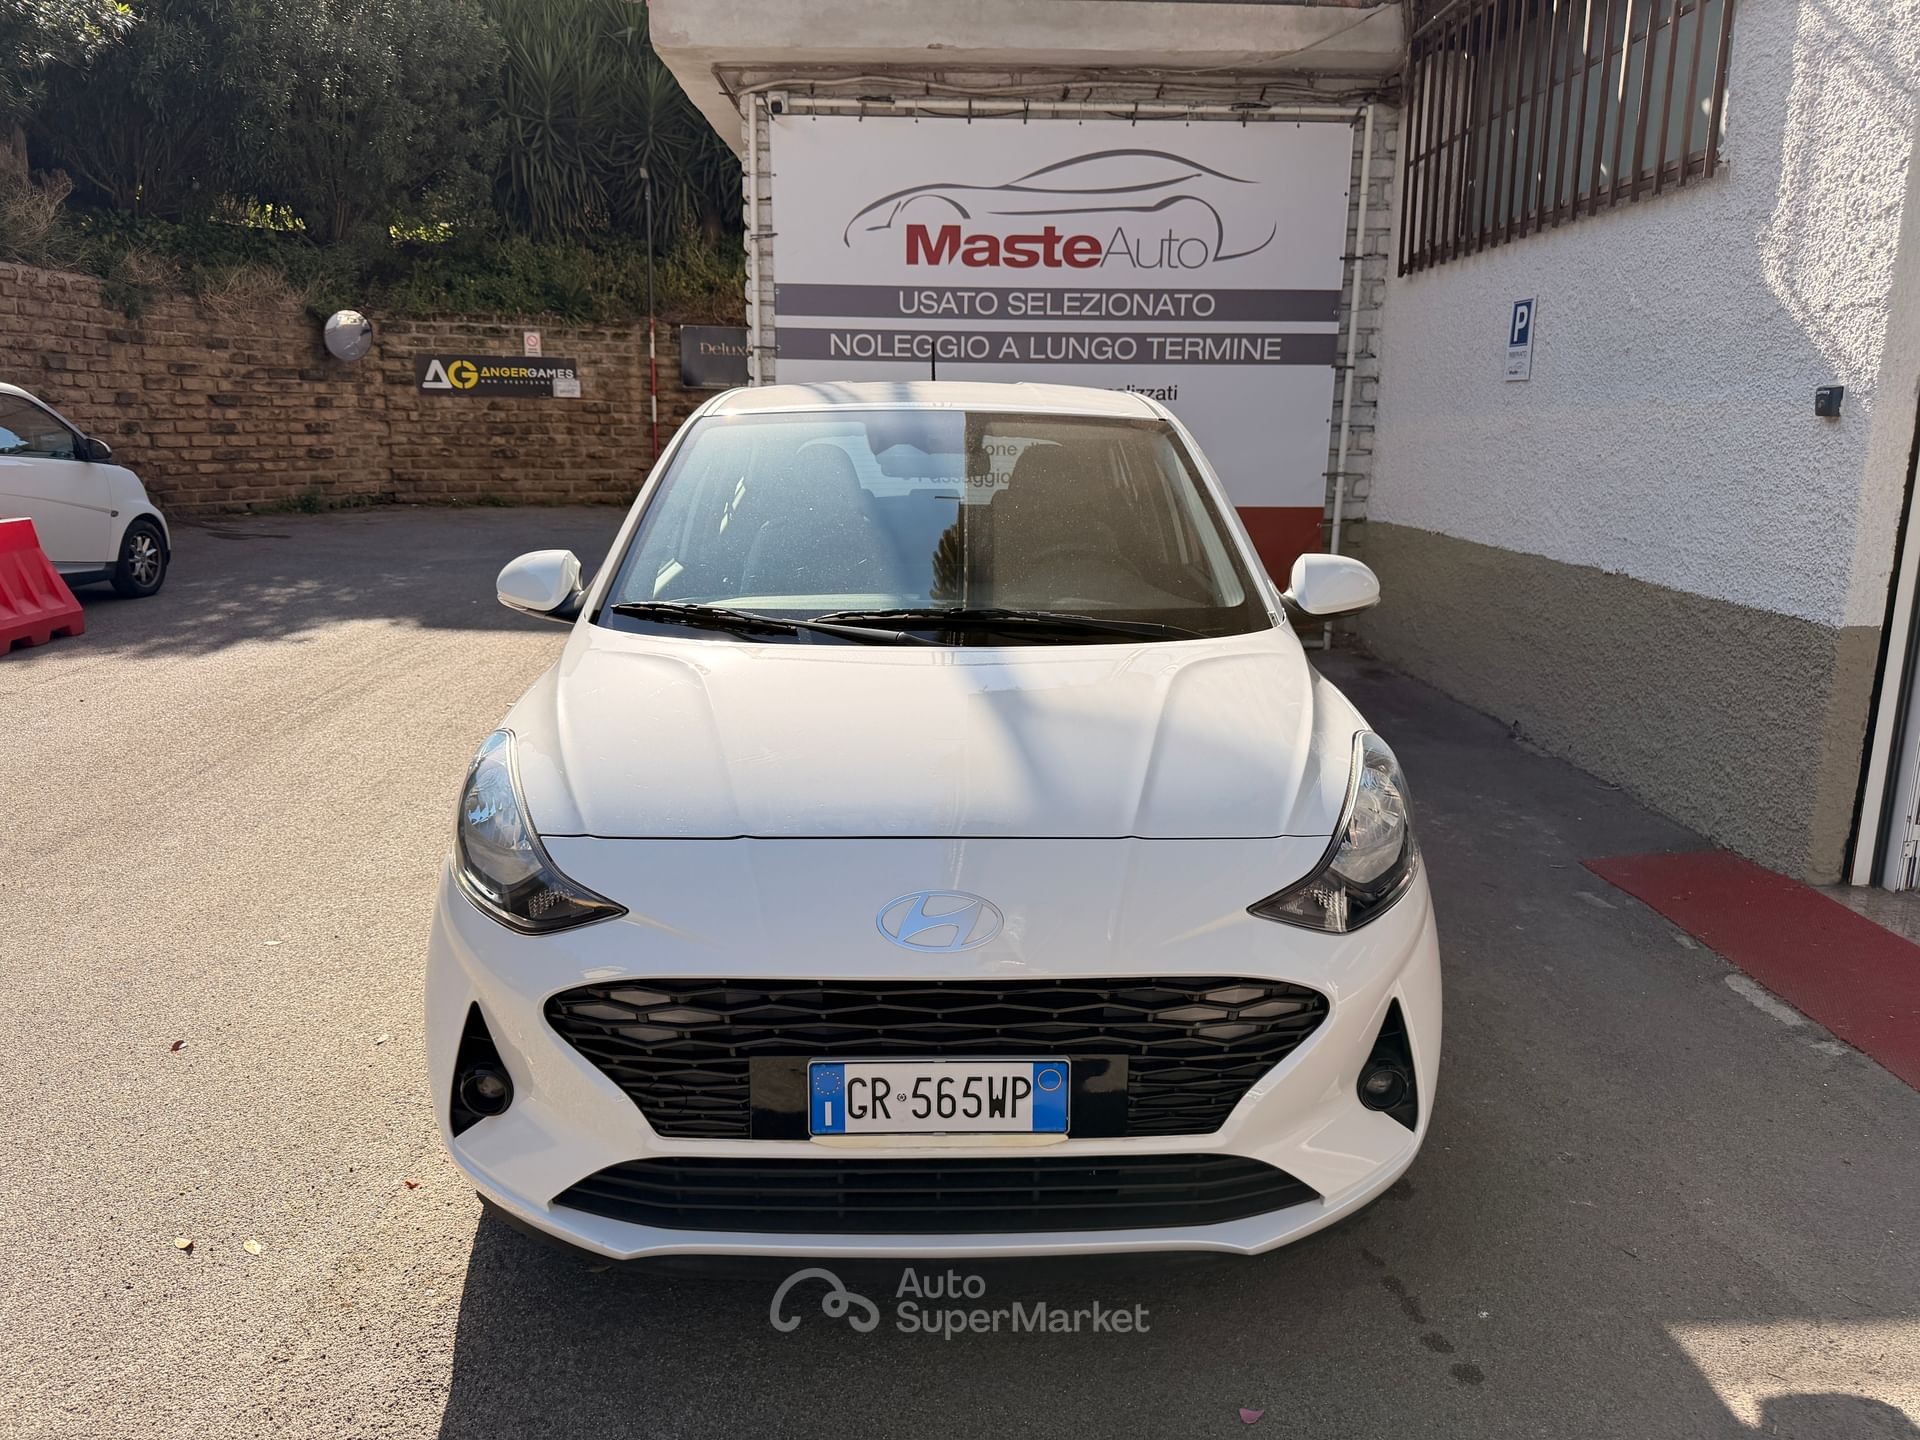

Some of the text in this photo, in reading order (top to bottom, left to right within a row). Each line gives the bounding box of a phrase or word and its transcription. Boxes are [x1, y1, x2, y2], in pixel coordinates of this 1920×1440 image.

[899, 290, 1216, 317] USATO SELEZIONATO
[1513, 305, 1529, 343] P
[700, 342, 753, 356] Delux
[830, 333, 1282, 361] NOLEGGIO A LUNGO TERMINE
[847, 1076, 1032, 1119] GR 565WP
